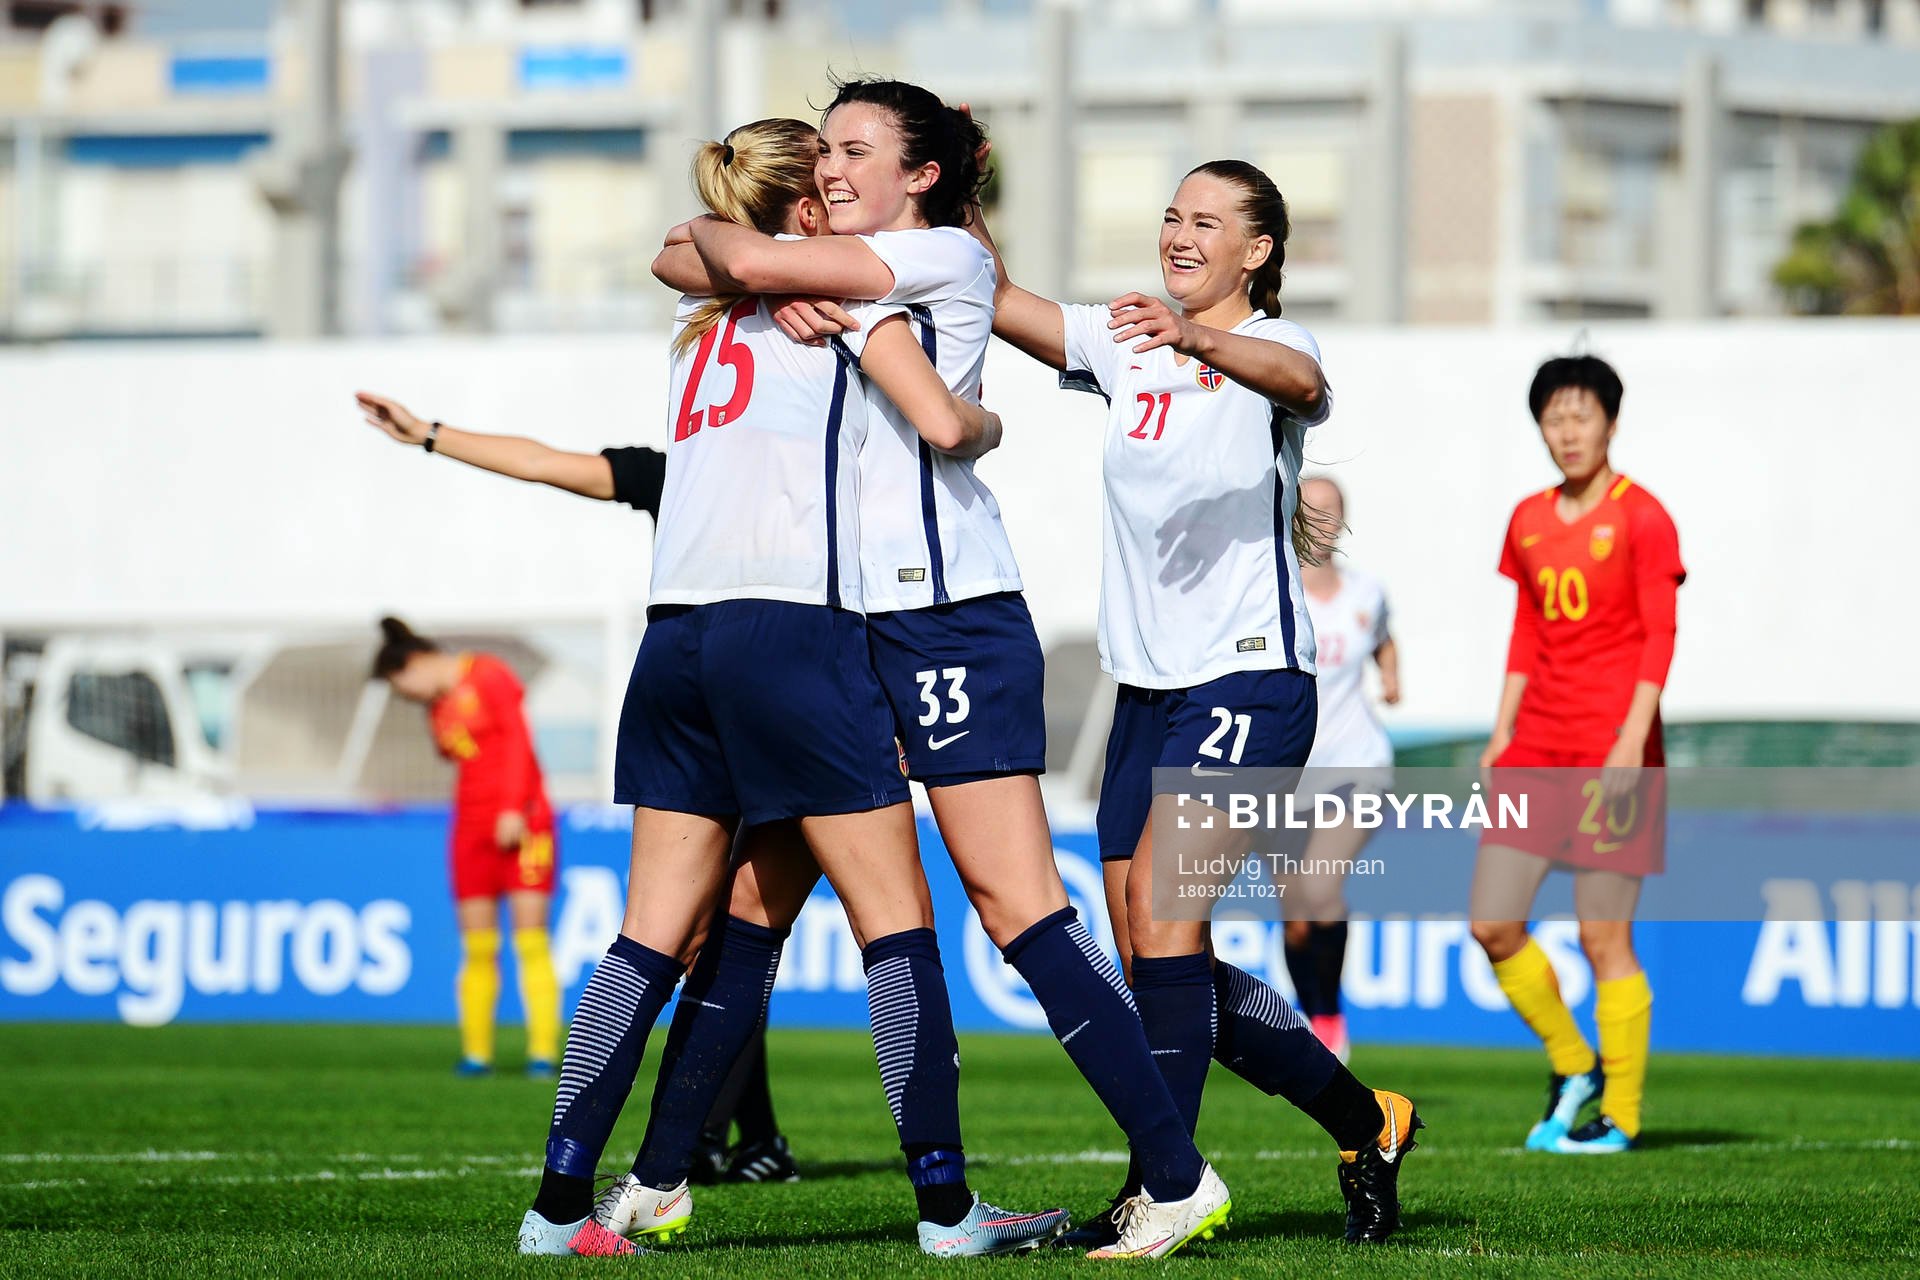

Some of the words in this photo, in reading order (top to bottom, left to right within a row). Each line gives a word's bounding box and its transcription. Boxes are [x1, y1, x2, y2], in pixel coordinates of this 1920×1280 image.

[674, 295, 760, 443] 25
[1127, 392, 1172, 441] 21
[1537, 566, 1589, 621] 20
[915, 666, 971, 727] 33
[1198, 706, 1252, 765] 21
[1577, 778, 1637, 836] 20
[0, 872, 413, 1028] Seguros
